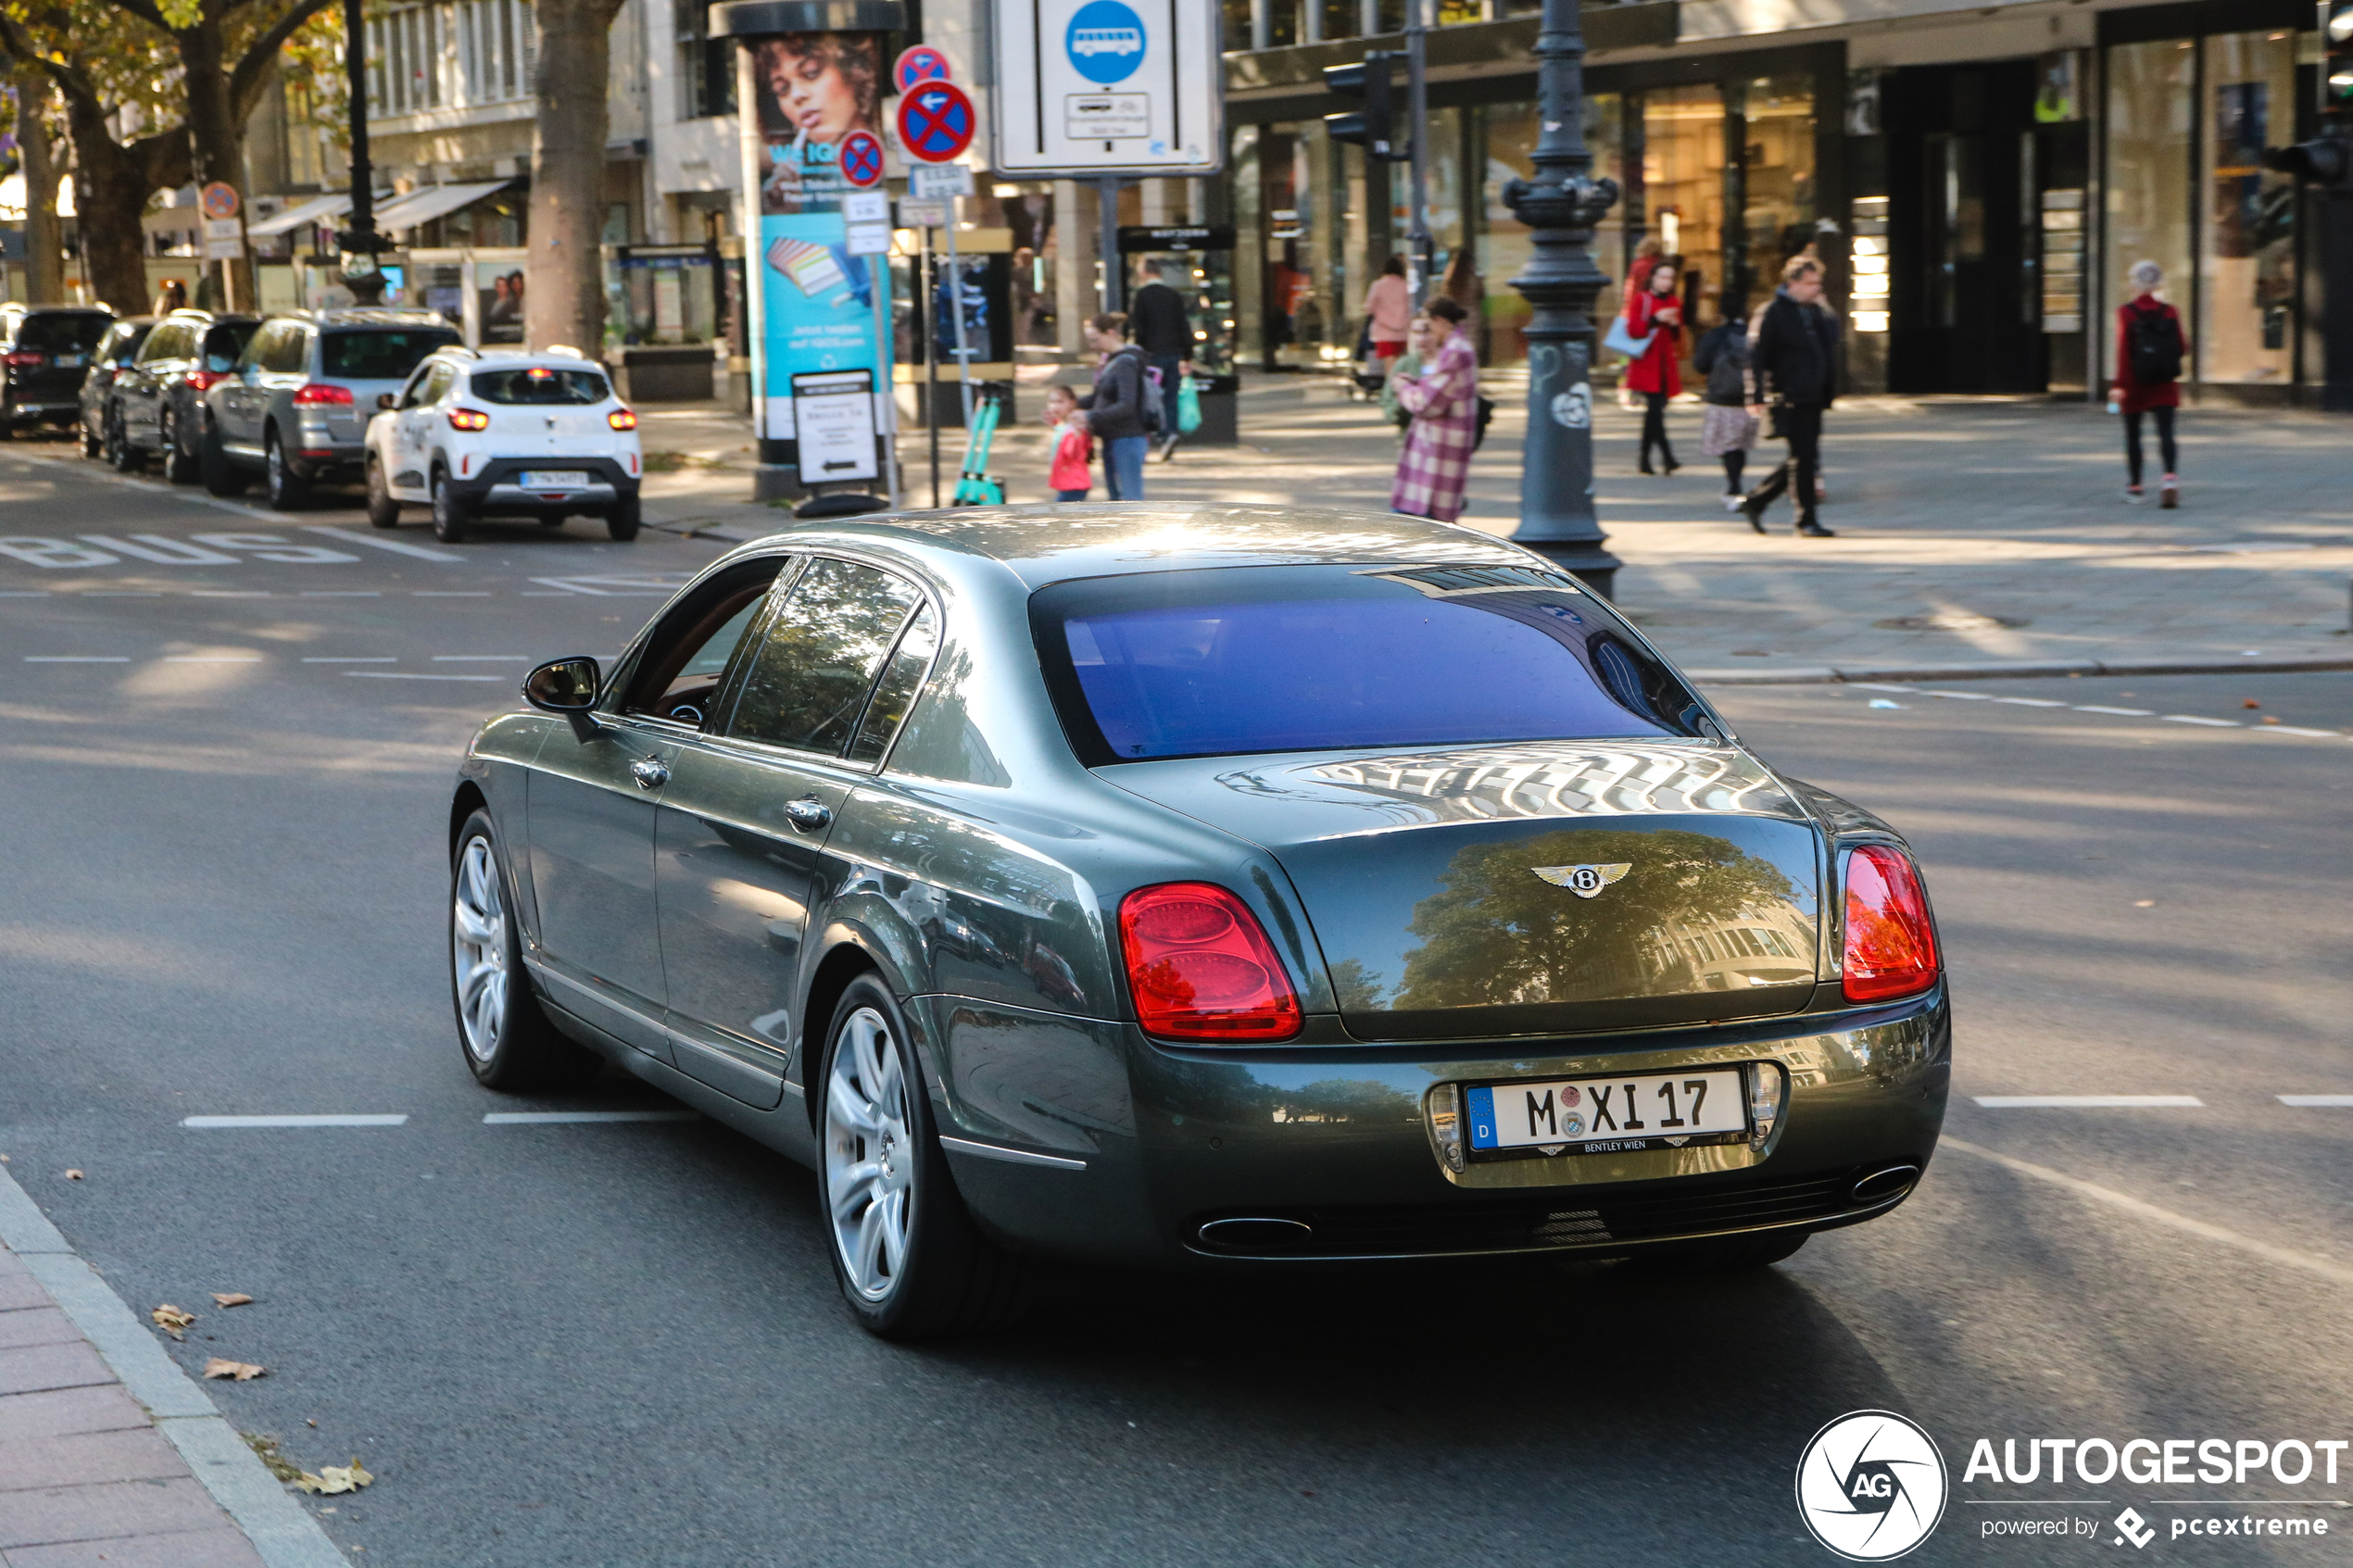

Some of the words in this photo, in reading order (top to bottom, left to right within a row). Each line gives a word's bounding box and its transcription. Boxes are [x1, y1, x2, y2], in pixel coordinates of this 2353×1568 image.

[0, 533, 362, 569] BUS
[1526, 1089, 1557, 1137] M
[1588, 1085, 1644, 1132] XI
[1657, 1079, 1708, 1128] 17
[1478, 1124, 1490, 1138] D
[1584, 1141, 1622, 1153] BENTLEY
[1623, 1140, 1646, 1150] WIEN
